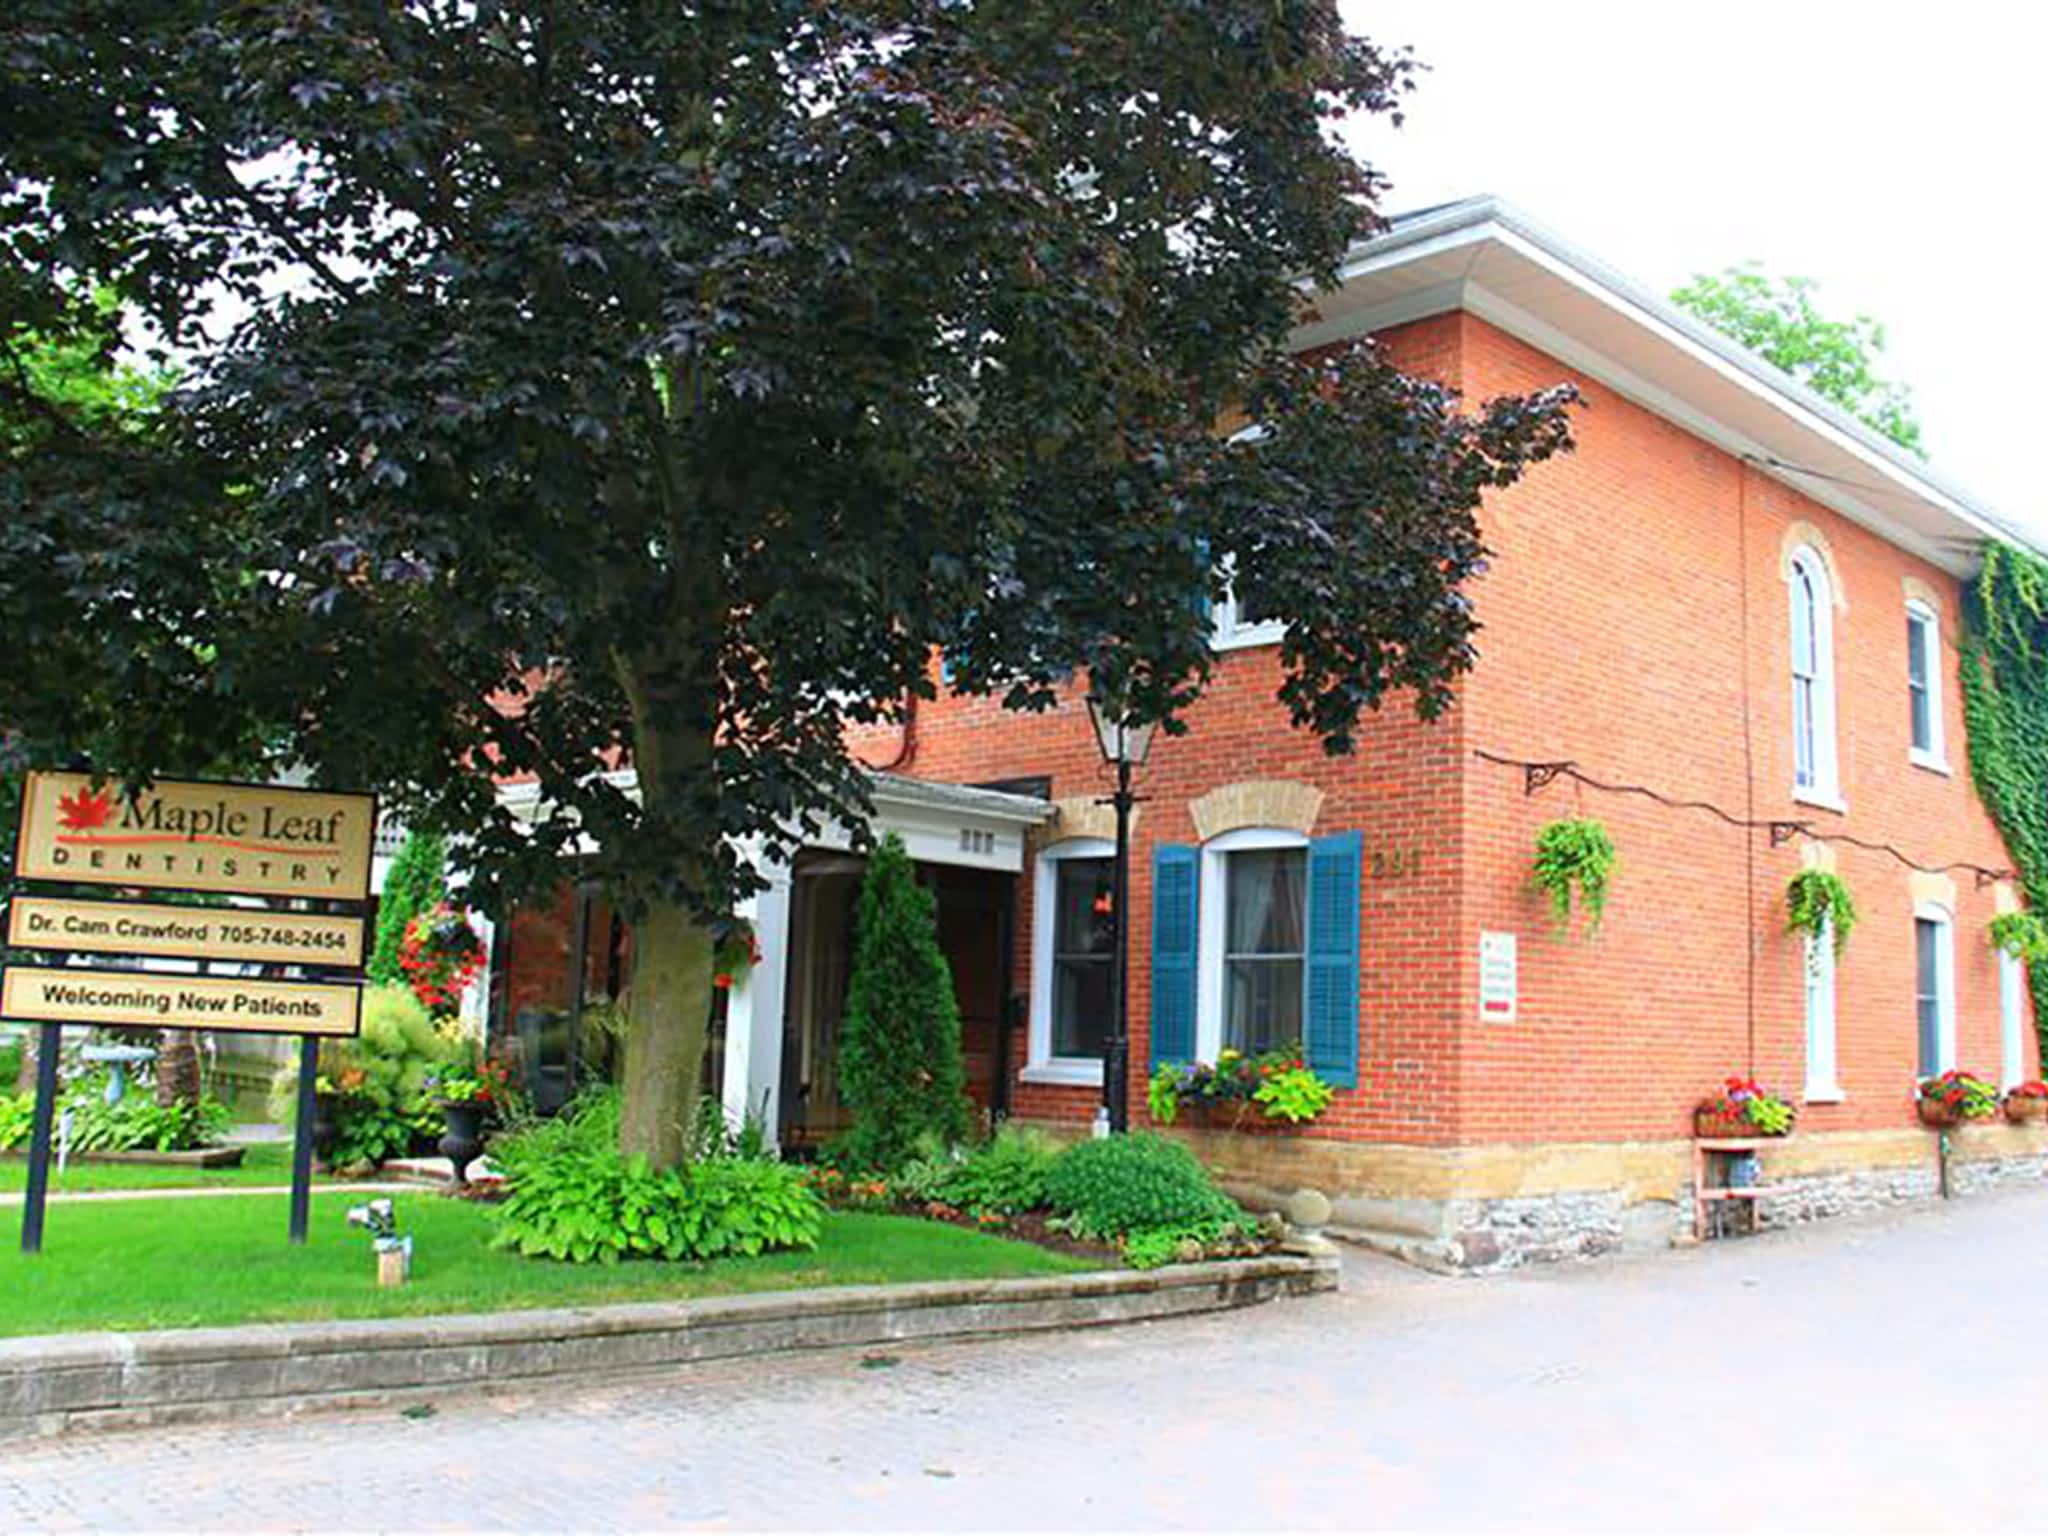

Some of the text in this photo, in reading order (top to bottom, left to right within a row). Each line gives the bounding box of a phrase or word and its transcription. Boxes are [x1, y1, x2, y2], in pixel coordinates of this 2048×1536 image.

[119, 799, 346, 844] Maple Leaf
[52, 847, 342, 884] DENTISTRY
[28, 913, 346, 949] Dr. Cam Crawford 705-748-2454
[42, 983, 323, 1018] Welcoming New Patients
